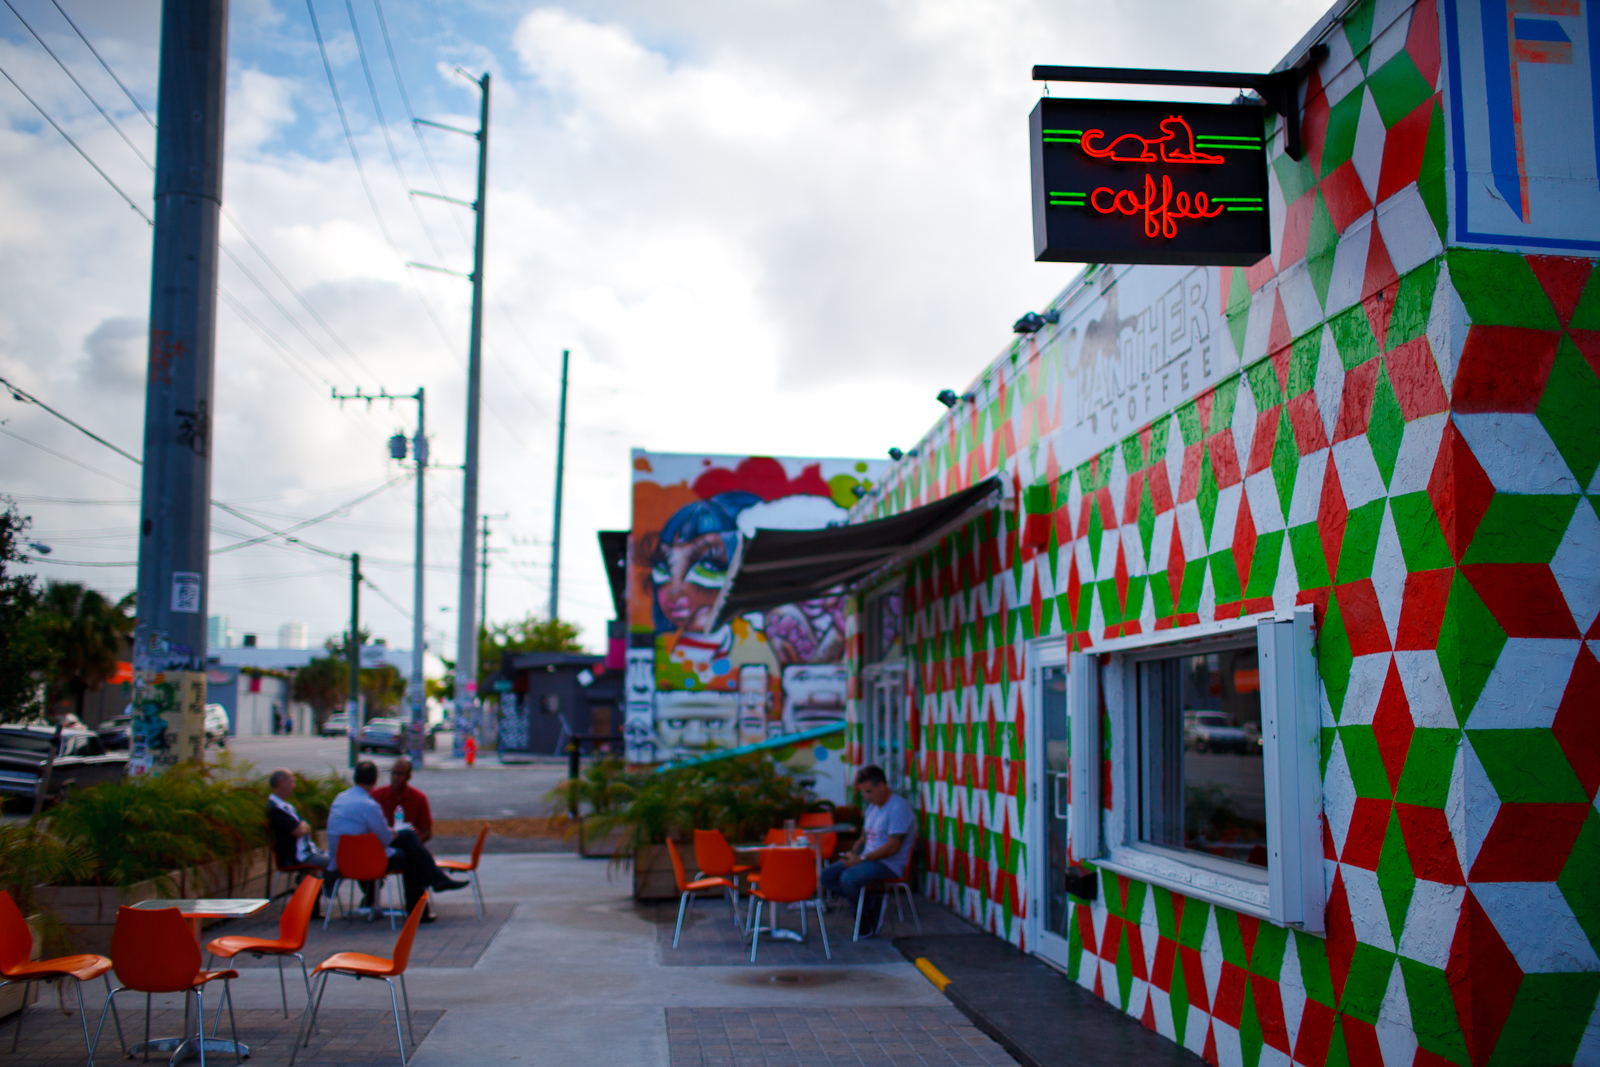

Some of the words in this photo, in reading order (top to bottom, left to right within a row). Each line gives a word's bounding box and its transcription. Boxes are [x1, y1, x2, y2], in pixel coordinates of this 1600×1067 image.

[1091, 172, 1224, 239] coffee
[1076, 266, 1210, 427] PANTHER
[1110, 346, 1212, 432] COFFEE
